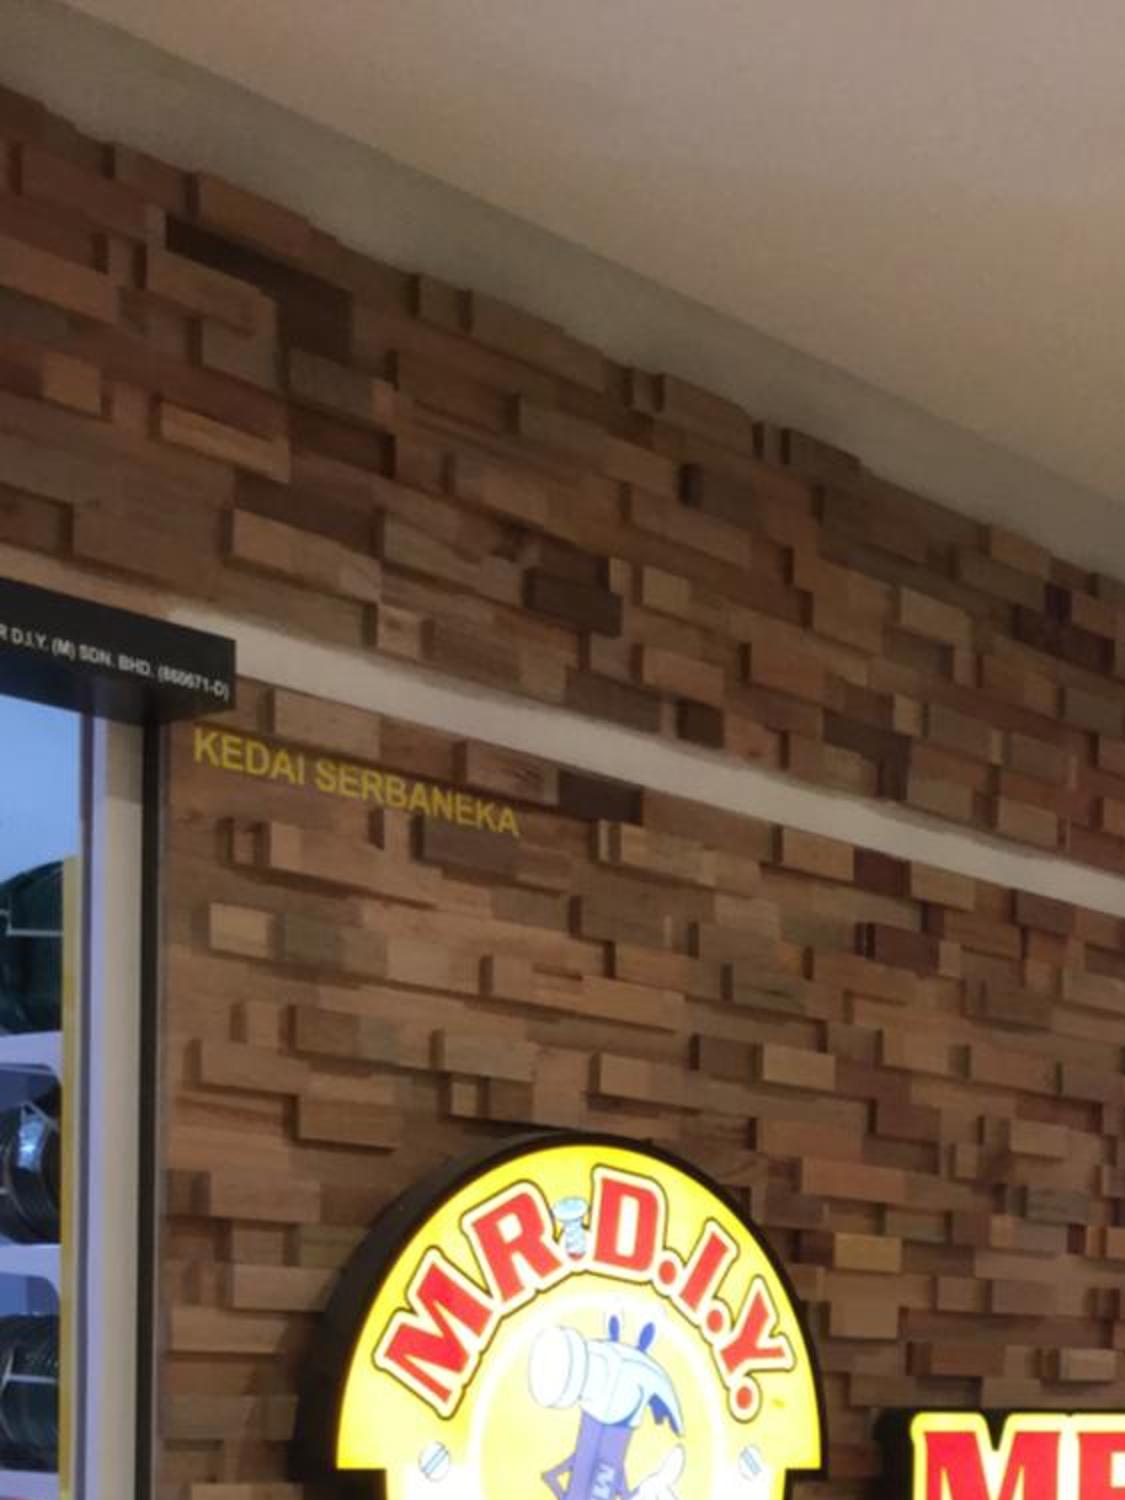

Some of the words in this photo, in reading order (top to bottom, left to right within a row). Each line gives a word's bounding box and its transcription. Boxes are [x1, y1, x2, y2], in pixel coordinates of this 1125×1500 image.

[11, 628, 49, 649] D.I.Y.
[52, 637, 76, 660] (M)
[79, 644, 114, 667] SDN.
[118, 653, 153, 678] BHD.
[193, 729, 305, 785] KEDAI
[314, 759, 519, 837] SERBANEKA
